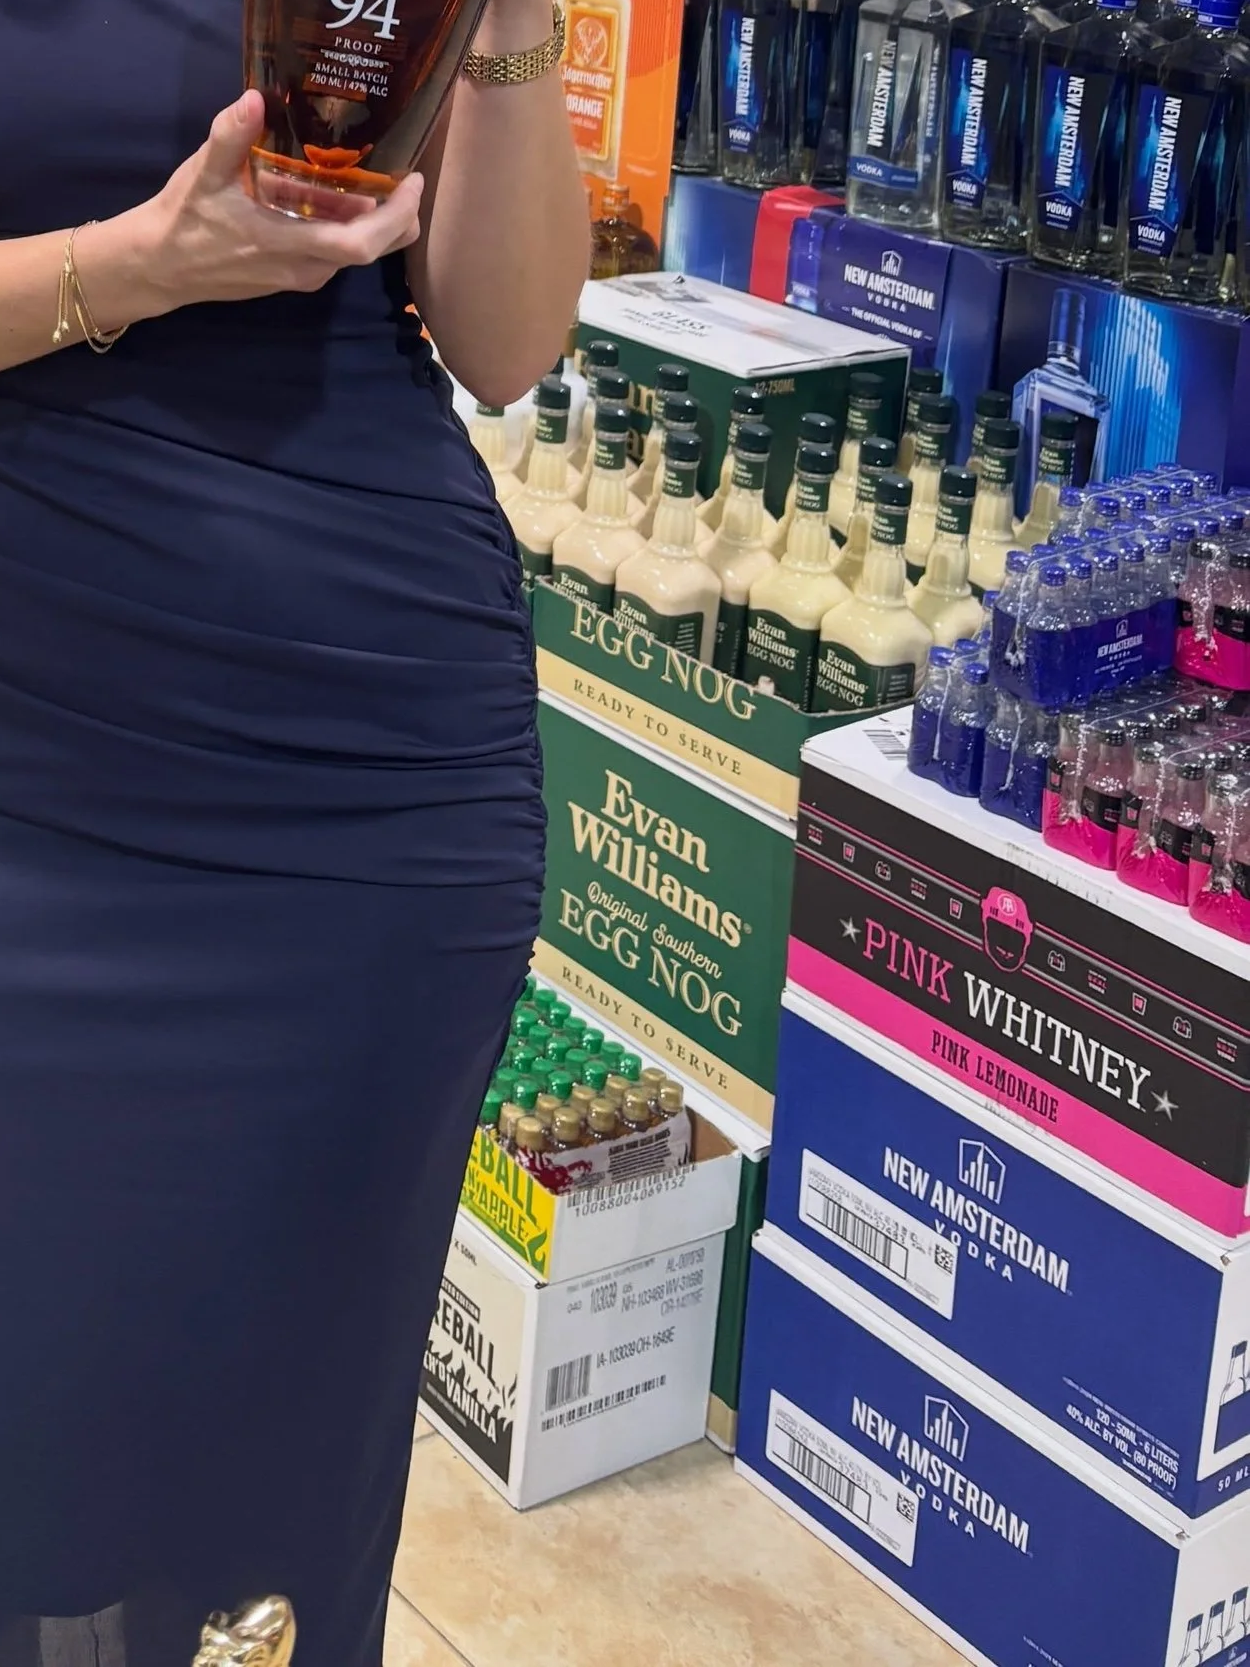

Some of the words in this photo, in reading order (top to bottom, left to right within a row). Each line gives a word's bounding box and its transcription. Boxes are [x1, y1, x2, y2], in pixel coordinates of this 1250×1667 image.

[334, 36, 382, 55] PROOF
[310, 72, 326, 85] 750
[328, 76, 342, 88] ML
[349, 81, 367, 93] 47%
[369, 85, 388, 97] ALC
[314, 61, 350, 78] SMALL
[353, 70, 388, 85] BATCH
[735, 40, 754, 117] AMSTERDAM
[972, 57, 988, 86] NEW
[1067, 76, 1085, 106] NEW
[565, 93, 604, 119] ORANGE
[867, 66, 893, 148] AMSTERDAM
[961, 84, 985, 166] AMSTERDAM
[1162, 96, 1182, 127] NEW
[729, 128, 751, 142] VODKA
[1054, 104, 1082, 188] AMSTERDAM
[856, 162, 883, 178] VODKA
[952, 179, 977, 195] VODKA
[1148, 126, 1178, 212] AMSTERDAM
[1045, 200, 1072, 217] VODKA
[1137, 224, 1165, 243] VODKA
[844, 264, 868, 287] NEW
[867, 272, 936, 311] AMSTERDAM
[867, 292, 907, 313] VODKA
[851, 306, 864, 320] THE
[863, 309, 891, 329] OFFICIAL
[891, 319, 913, 337] VODKA
[912, 329, 923, 339] OF
[560, 572, 589, 596] Evan
[620, 598, 648, 624] Evan
[755, 616, 787, 642] Evan
[570, 602, 654, 670] EGG
[660, 646, 758, 720] NOG
[746, 643, 769, 661] EGG
[769, 650, 795, 671] NOG
[747, 625, 799, 659] Williams
[826, 648, 857, 676] Evan
[816, 675, 838, 696] EGG
[837, 684, 864, 707] NOG
[818, 657, 868, 695] Williams
[573, 678, 635, 720] READY
[643, 714, 669, 737] TO
[678, 732, 742, 776] SERVE
[600, 768, 710, 874] Evan
[567, 800, 743, 949] Williams
[586, 880, 649, 933] Original
[652, 922, 723, 980] Southern
[557, 888, 641, 971] EGG
[647, 944, 743, 1037] NOG
[561, 965, 622, 1015] READY
[630, 1013, 656, 1039] TO
[664, 1036, 729, 1090] SERVE
[862, 917, 954, 1004] PINK
[963, 970, 1152, 1110] WHITNEY
[931, 1029, 970, 1073] PINK
[974, 1054, 1060, 1124] LEMONADE
[478, 1182, 528, 1242] APPLE
[883, 1146, 930, 1201] NEW
[929, 1179, 1070, 1294] AMSTERDAM
[934, 1218, 1013, 1283] VODKA
[446, 1379, 498, 1444] VANILLA
[1066, 1403, 1084, 1425] 40%
[1084, 1415, 1102, 1437] ALC.
[1102, 1427, 1114, 1445] BY
[1114, 1436, 1132, 1459] VOL.
[1133, 1449, 1147, 1467] (80
[1146, 1459, 1177, 1491] PROOF)
[1095, 1407, 1111, 1427] 120
[1116, 1424, 1138, 1447] 50ML
[1143, 1441, 1151, 1452] 6
[1151, 1447, 1180, 1474] LITERS
[851, 1395, 897, 1452] NEW
[896, 1431, 1030, 1554] AMSTERDAM
[1217, 1476, 1231, 1493] 50
[1235, 1465, 1249, 1483] ML
[900, 1469, 976, 1538] VODKA
